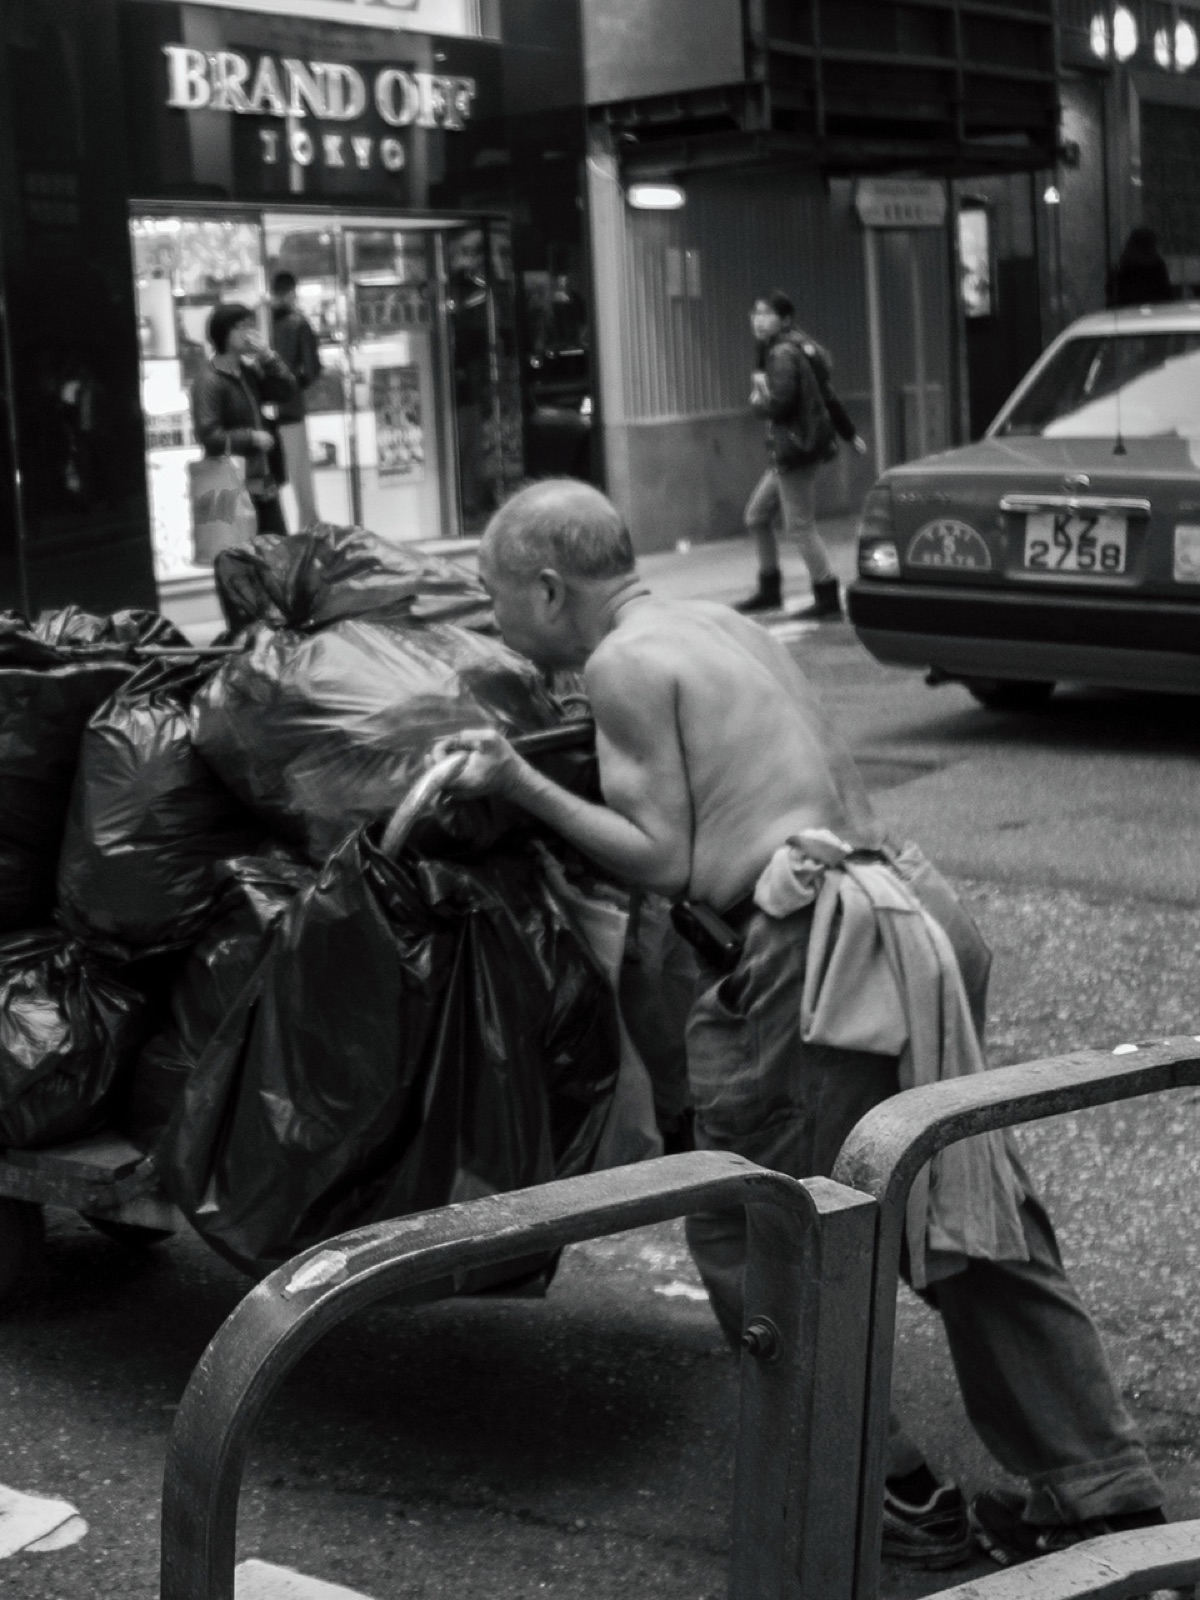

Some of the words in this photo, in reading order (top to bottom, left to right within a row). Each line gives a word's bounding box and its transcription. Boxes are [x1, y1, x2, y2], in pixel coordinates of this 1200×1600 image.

[162, 45, 366, 121] BRAND
[374, 67, 476, 131] OFF
[259, 129, 406, 172] TOKYO
[1053, 511, 1099, 545] KZ
[1029, 540, 1121, 570] 2758
